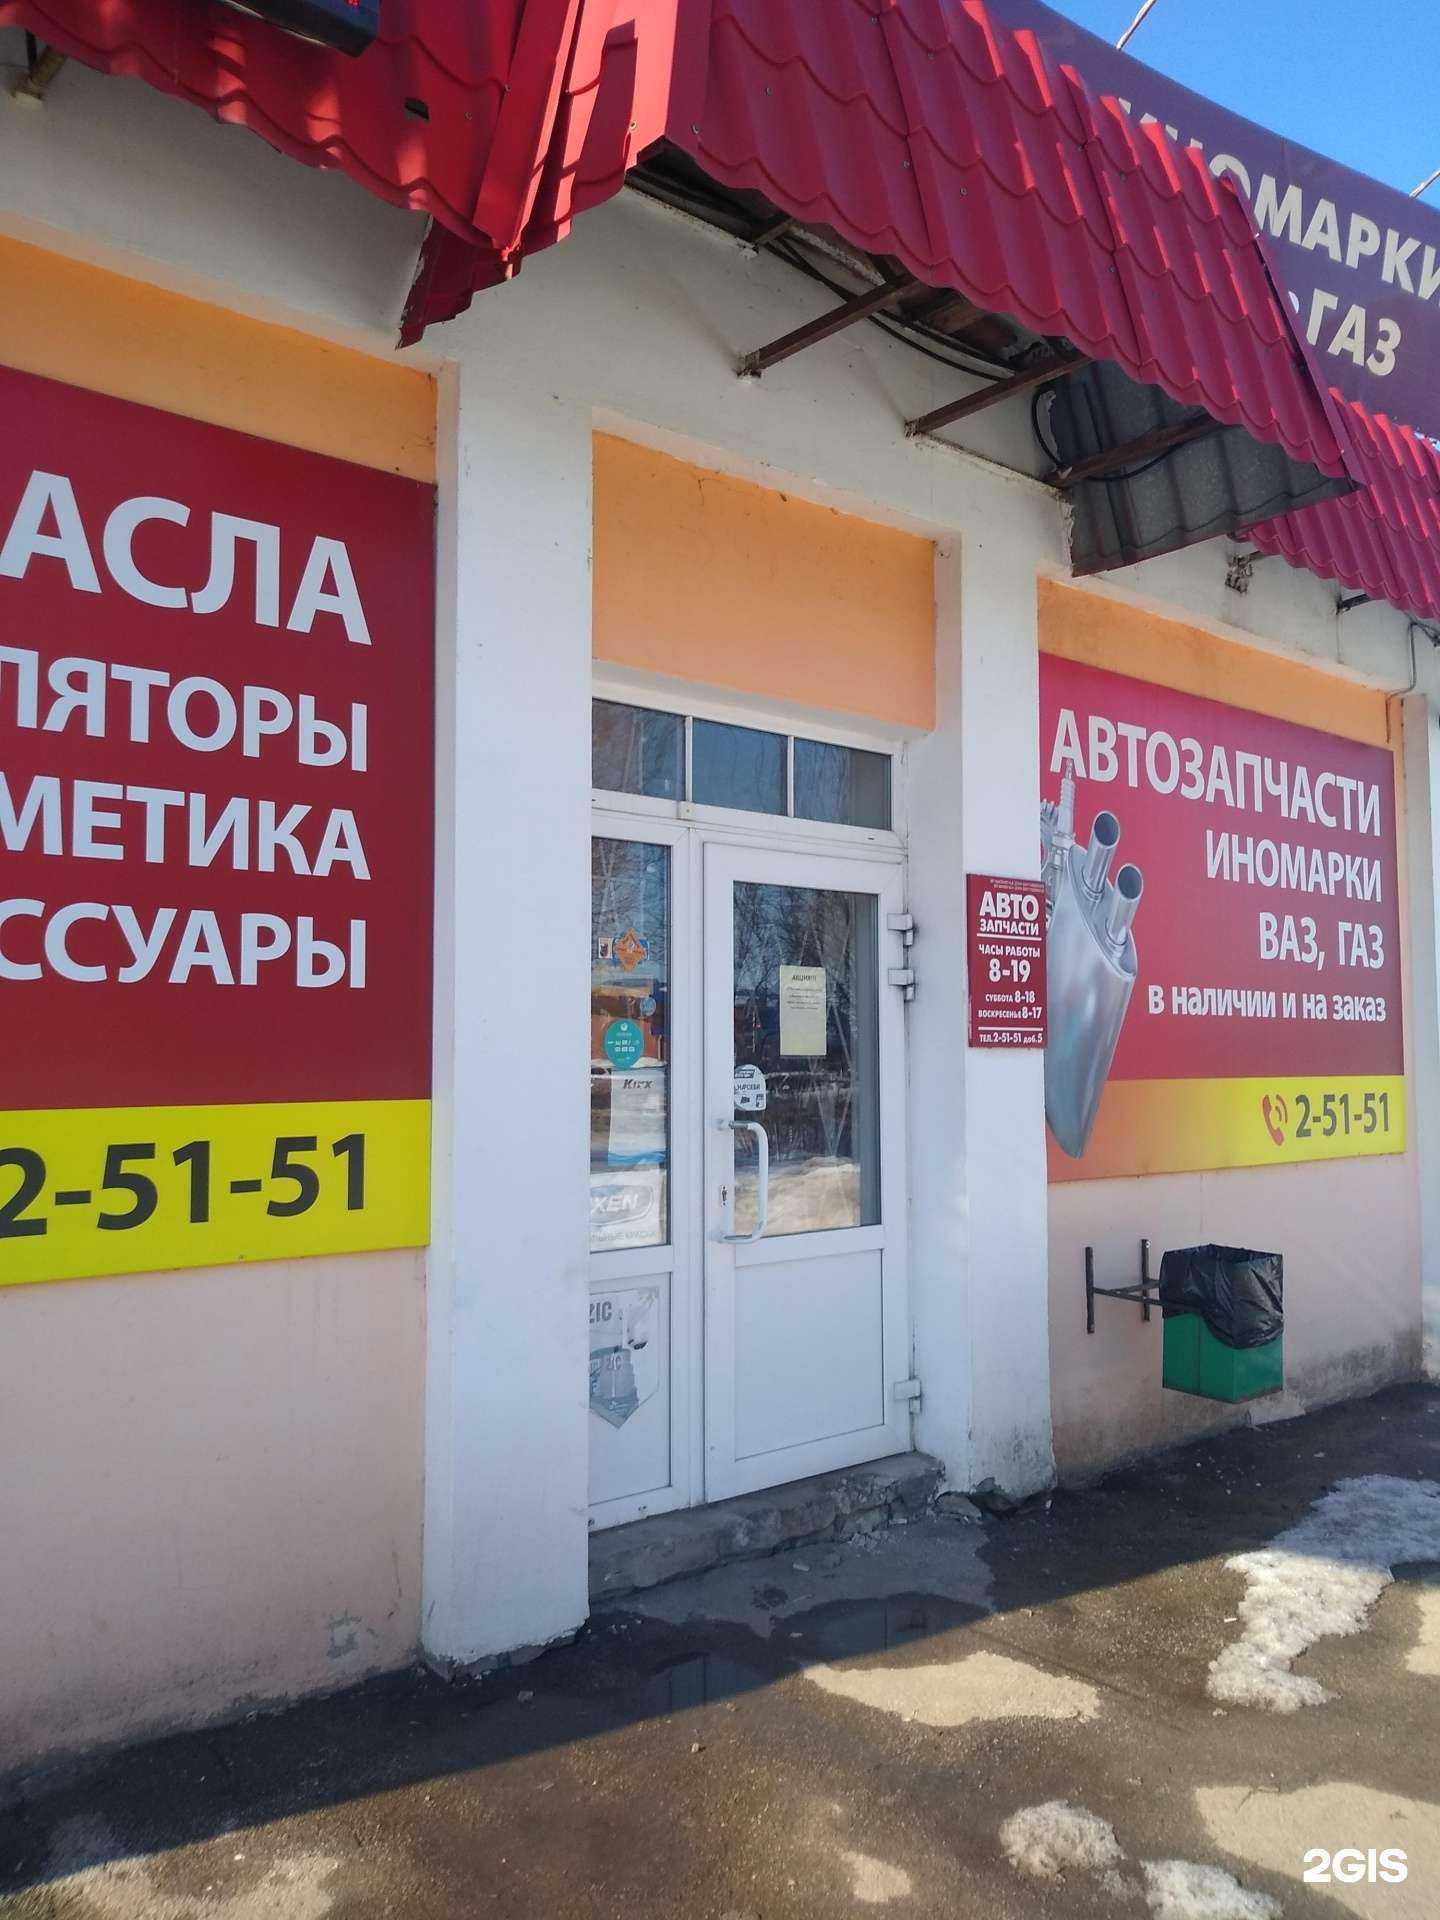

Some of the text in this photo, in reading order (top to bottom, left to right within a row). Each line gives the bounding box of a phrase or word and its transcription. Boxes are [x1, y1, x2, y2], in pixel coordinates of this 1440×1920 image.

[1306, 288, 1402, 377] ГАЗ
[0, 469, 371, 646] АСЛА
[1050, 708, 1381, 837] АВТОЗАПЧАСТИ
[0, 771, 371, 881] МЕТИКА
[1205, 829, 1382, 903] ИНОМАРКИ
[980, 891, 1039, 921] АВТО
[980, 919, 1039, 936] ЗАПЧАСТИ
[0, 898, 367, 989] ССУАРЫ
[979, 944, 1041, 958] ЧАСЫ РАБОТЫ
[1259, 911, 1385, 971] ВАЗ, ГАЗ
[989, 958, 1031, 983] 8-19
[985, 990, 1036, 1004] СУББОТА 8-18
[1021, 1006, 1042, 1019] 8-17
[1171, 985, 1276, 1018] наличии
[1282, 992, 1297, 1019] и
[1302, 993, 1327, 1020] на
[1332, 994, 1387, 1022] заказ
[993, 1032, 1022, 1043] 2-51-51
[1295, 1092, 1389, 1138] 2-51-51
[0, 1133, 366, 1240] 2-51-51
